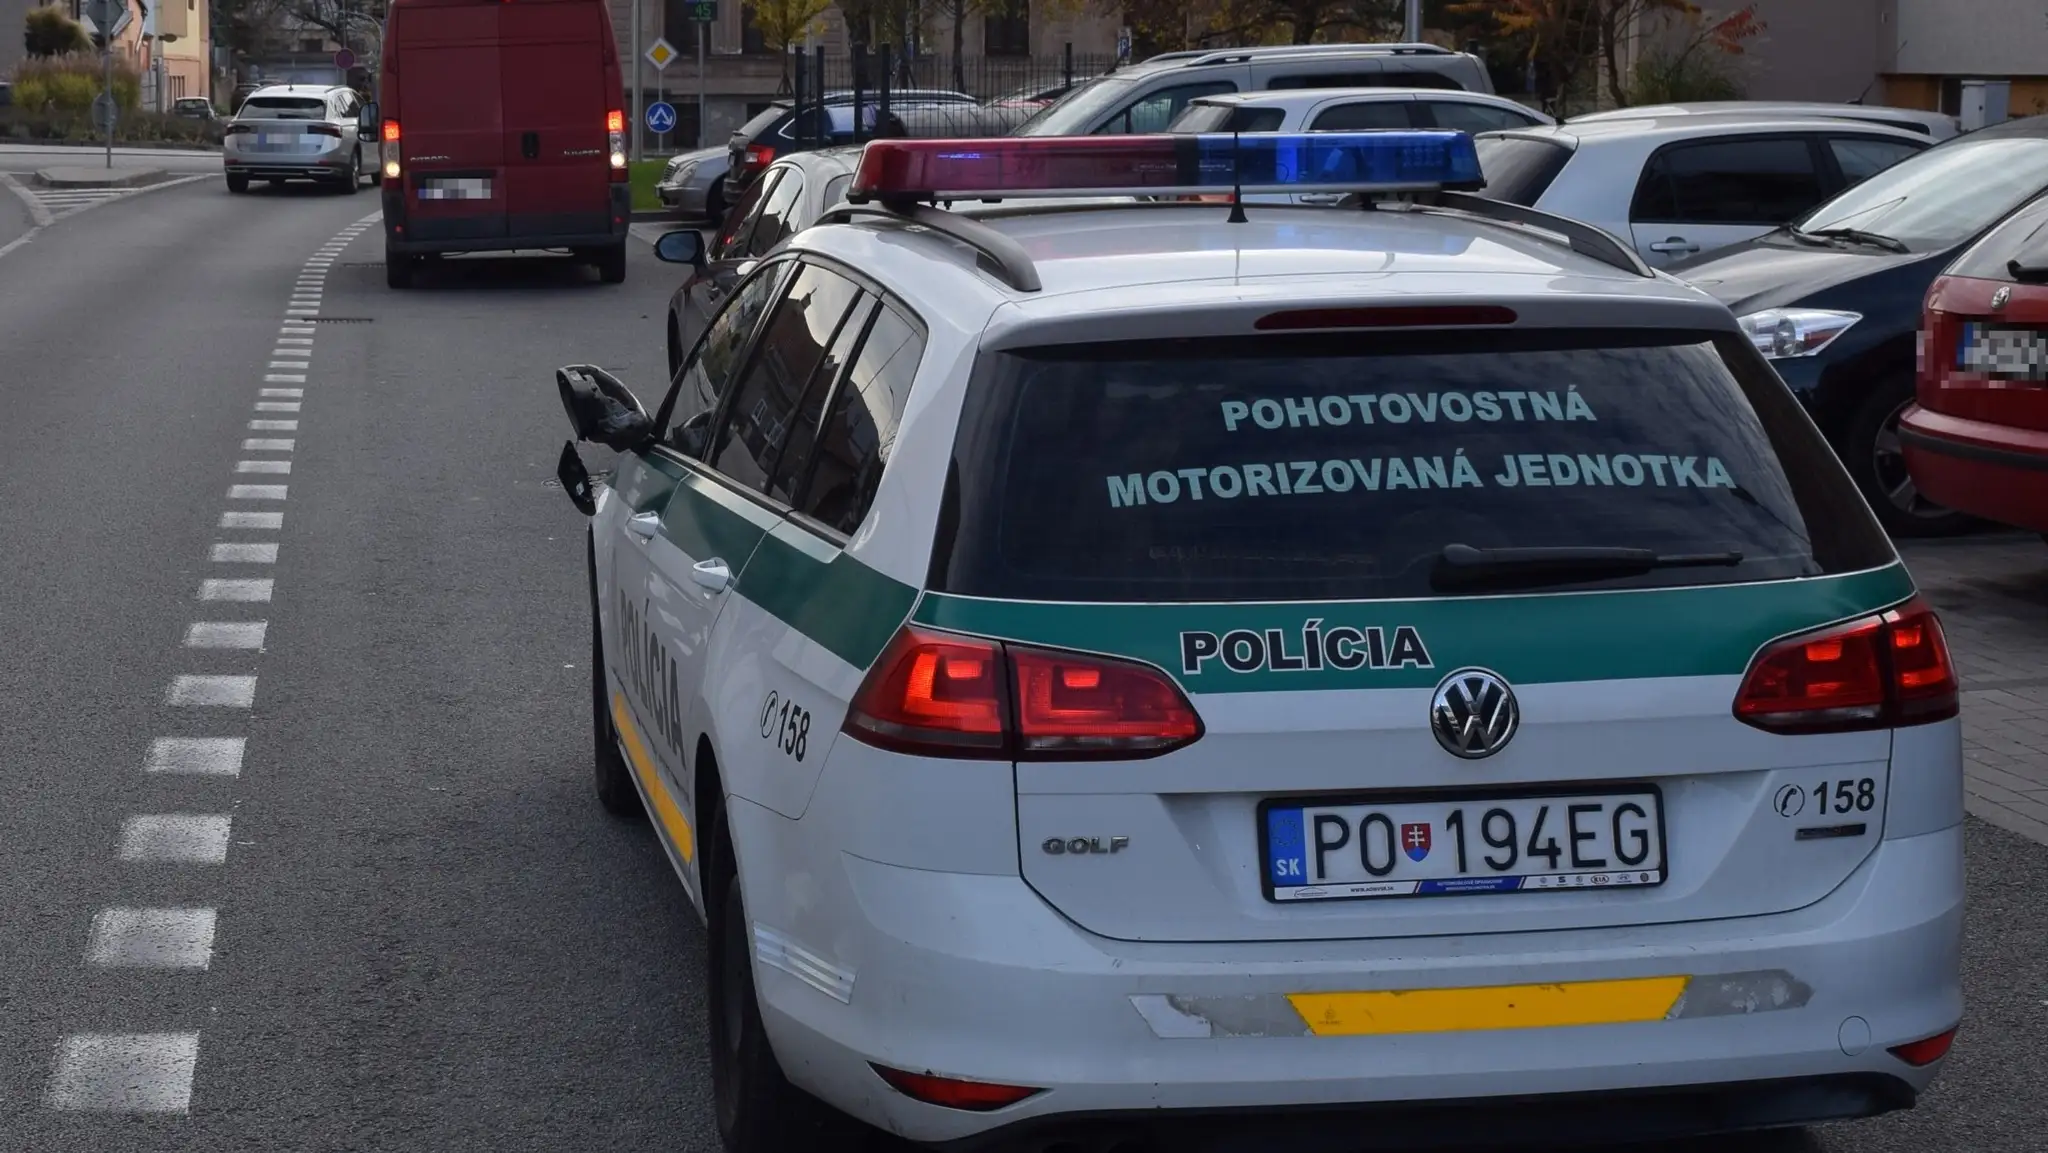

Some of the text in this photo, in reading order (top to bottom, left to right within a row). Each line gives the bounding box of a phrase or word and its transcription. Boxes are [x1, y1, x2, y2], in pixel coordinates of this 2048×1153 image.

[1221, 385, 1597, 431] POHOTOVOSTNÁ
[1106, 448, 1738, 508] MOTORIZOVANÁ JEDNOTKA
[1180, 618, 1435, 675] POLÍCIA
[620, 589, 687, 772] POLÍCIA
[777, 699, 811, 762] 158
[1813, 778, 1875, 815] 158
[1041, 836, 1129, 855] GOLF
[1276, 857, 1300, 876] SK
[1313, 802, 1649, 879] PO 194EG
